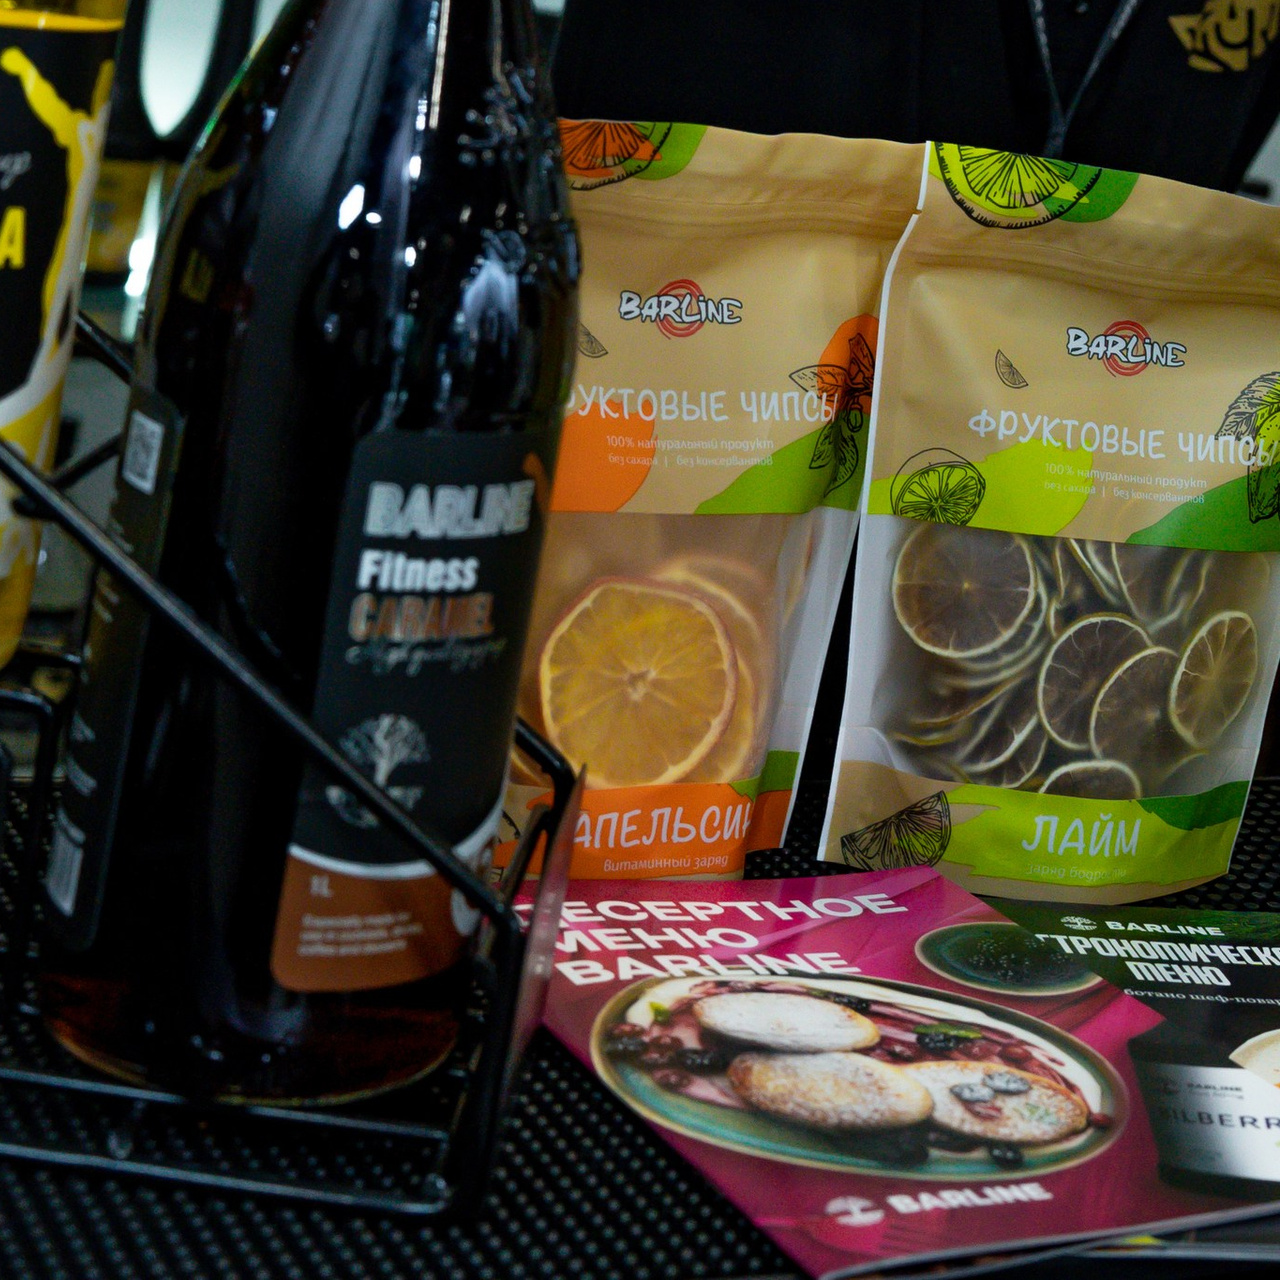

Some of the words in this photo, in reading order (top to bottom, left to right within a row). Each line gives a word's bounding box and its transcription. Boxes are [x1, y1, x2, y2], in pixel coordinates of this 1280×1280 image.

[740, 391, 839, 423] ЧИПСЫ
[606, 435, 635, 448] 100%
[967, 409, 1167, 460] ФРУКТОВЫЕ
[1177, 432, 1279, 467] ЧИПСЫ
[1045, 462, 1075, 476] 100%
[356, 548, 480, 592] Fitness
[1022, 813, 1142, 857] ЛАЙМ
[693, 855, 729, 870] заряд
[554, 927, 759, 954] МЕНЮ
[1105, 920, 1226, 937] BARLINE
[555, 951, 863, 986] BARLINE
[1125, 960, 1232, 987] МЕНЮ
[886, 1182, 1055, 1214] BARLINE
